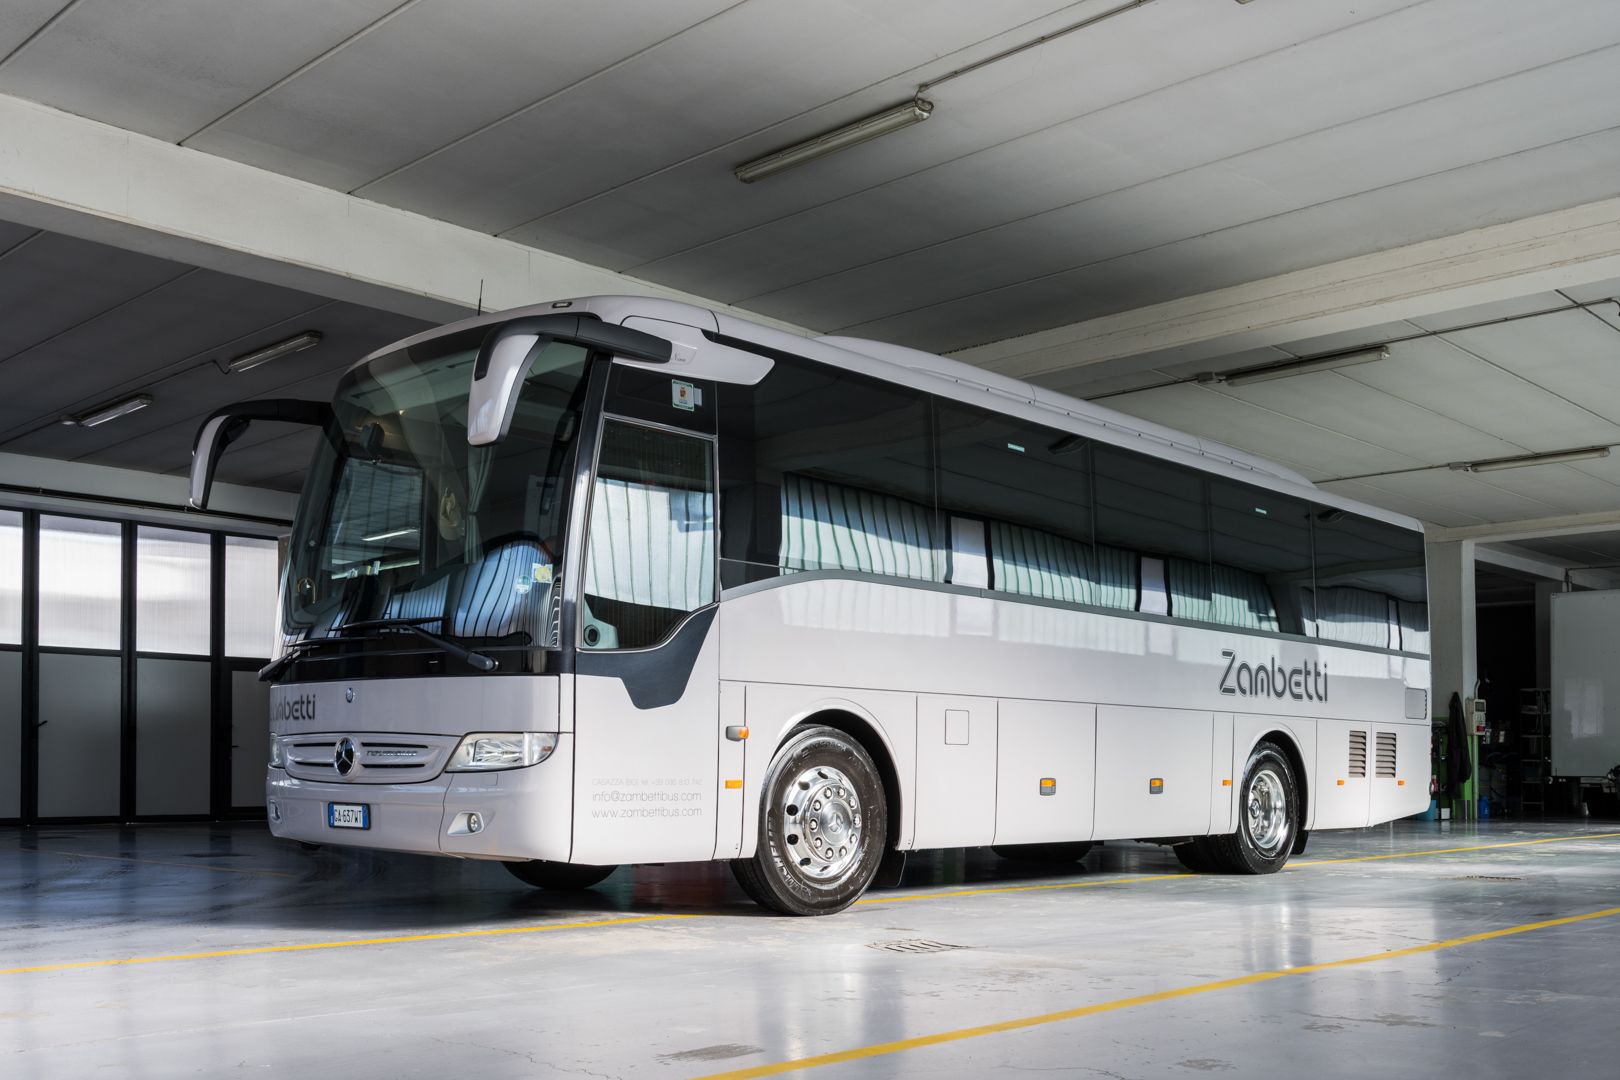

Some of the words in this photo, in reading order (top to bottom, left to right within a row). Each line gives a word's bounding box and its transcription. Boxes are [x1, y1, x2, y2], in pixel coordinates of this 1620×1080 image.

[1219, 650, 1328, 701] Zambetti
[592, 790, 702, 802] info@zambettibus.com
[592, 807, 703, 818] www.zambettibus.com
